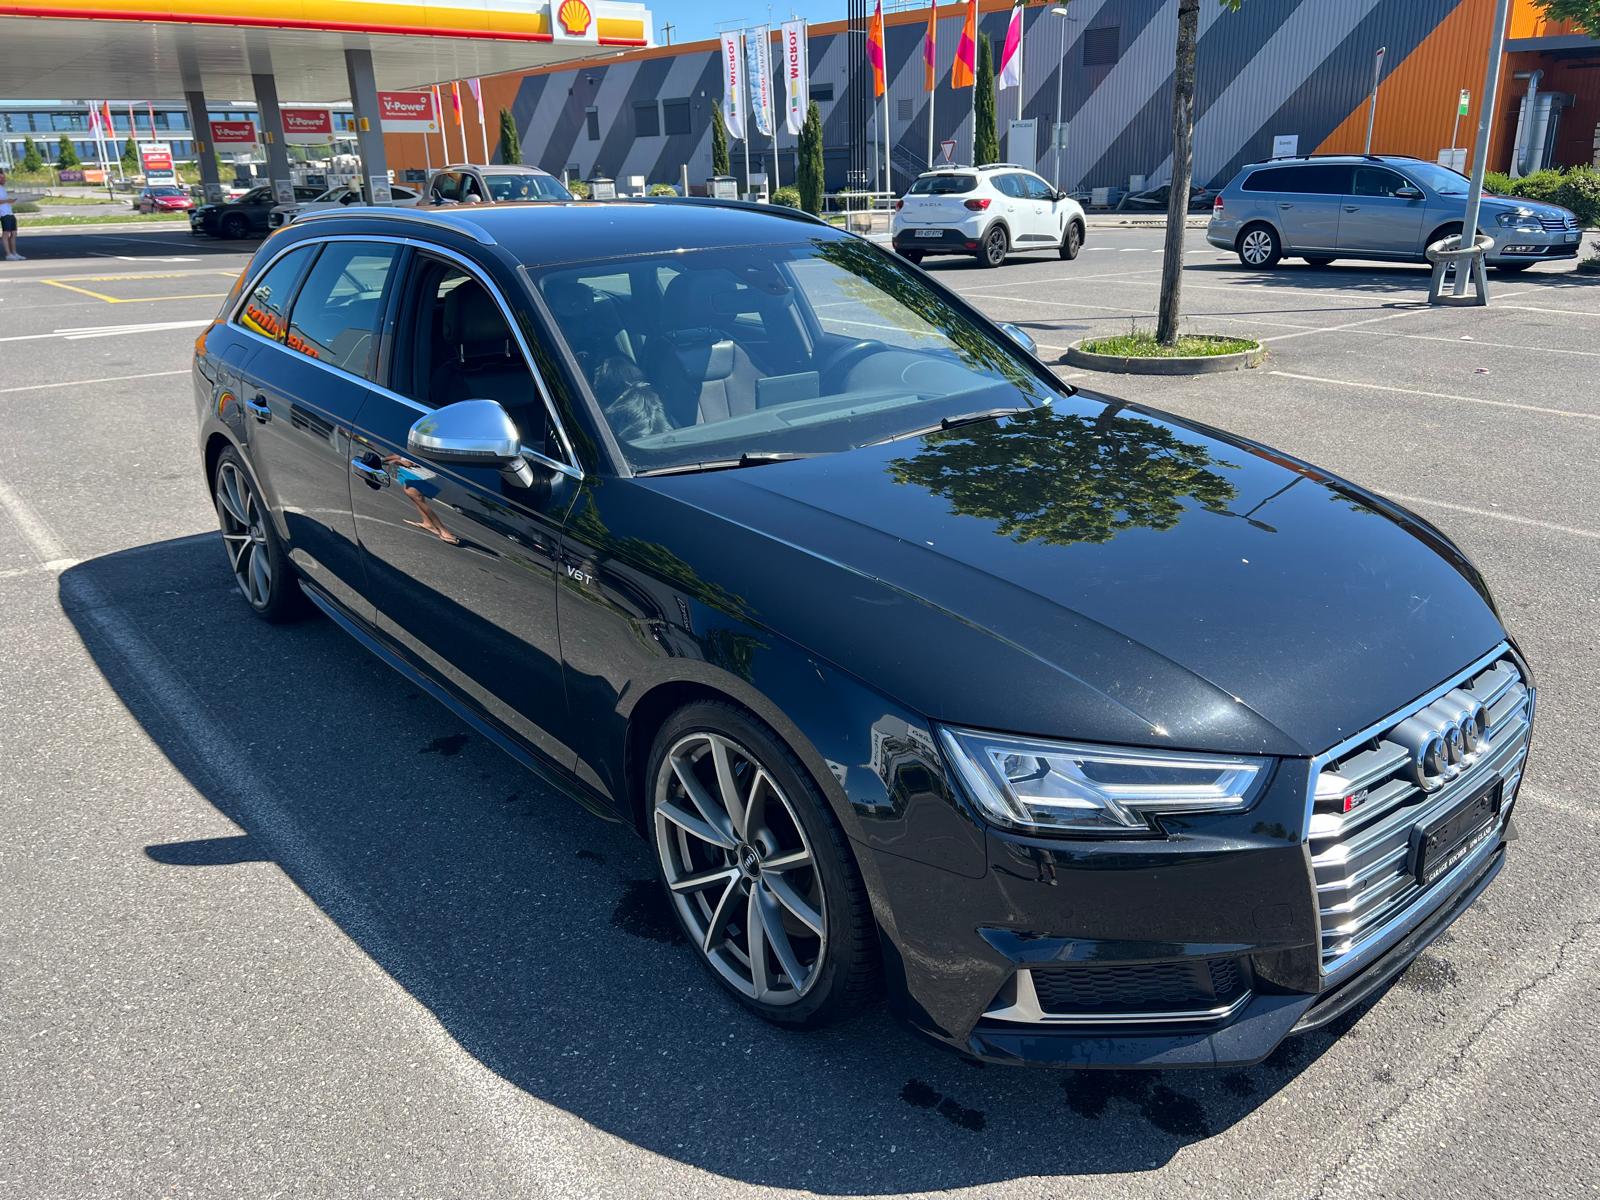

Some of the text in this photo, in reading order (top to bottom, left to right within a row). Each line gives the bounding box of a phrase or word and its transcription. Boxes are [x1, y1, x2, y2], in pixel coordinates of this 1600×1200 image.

[383, 101, 426, 111] V-Power
[287, 117, 324, 126] V-Power
[215, 128, 249, 136] V-Power
[567, 565, 593, 585] V6T
[1429, 861, 1448, 882] GARAGE
